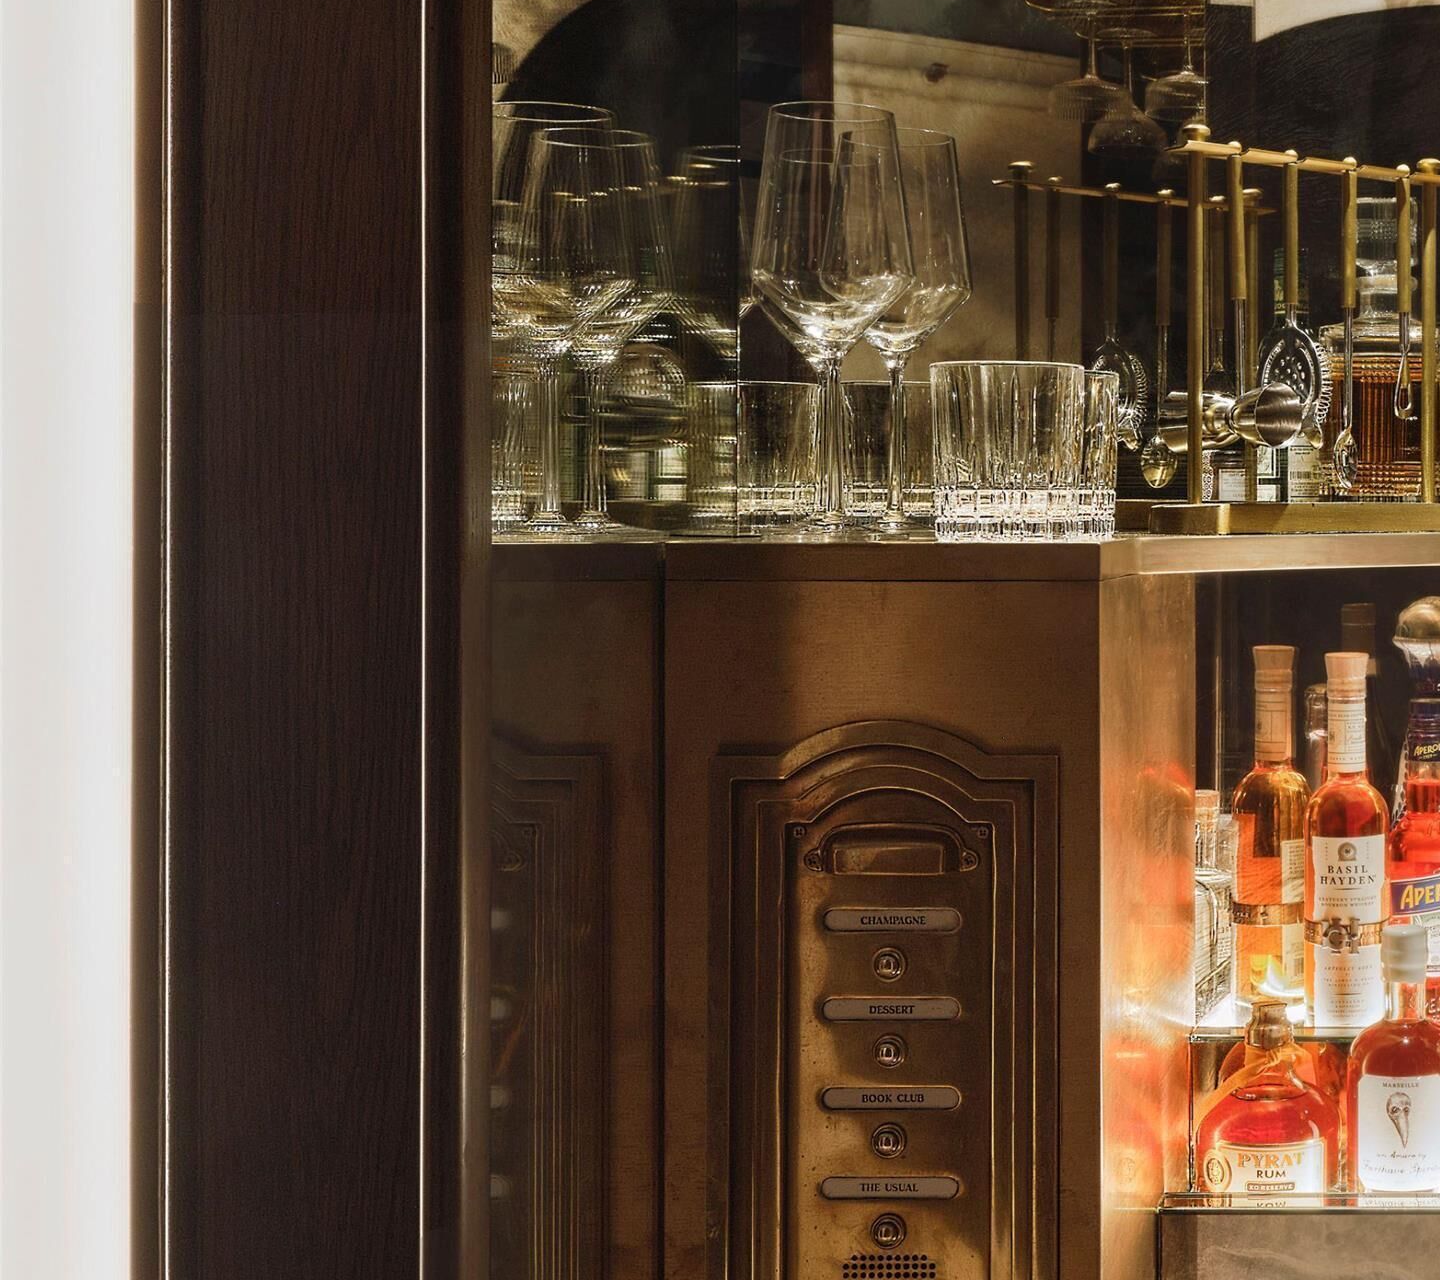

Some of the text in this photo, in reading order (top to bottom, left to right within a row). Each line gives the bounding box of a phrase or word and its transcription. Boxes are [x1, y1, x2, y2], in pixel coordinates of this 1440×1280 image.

[1328, 865, 1368, 874] BASIL
[1320, 875, 1375, 885] HAYDEN
[860, 915, 926, 926] CHAMPAGNE
[869, 1004, 915, 1015] DESSERT
[862, 1093, 925, 1104] BOOK CLUB
[1237, 1152, 1304, 1168] PYRAT
[1256, 1170, 1286, 1178] RUM
[860, 1183, 919, 1193] THE USUAL
